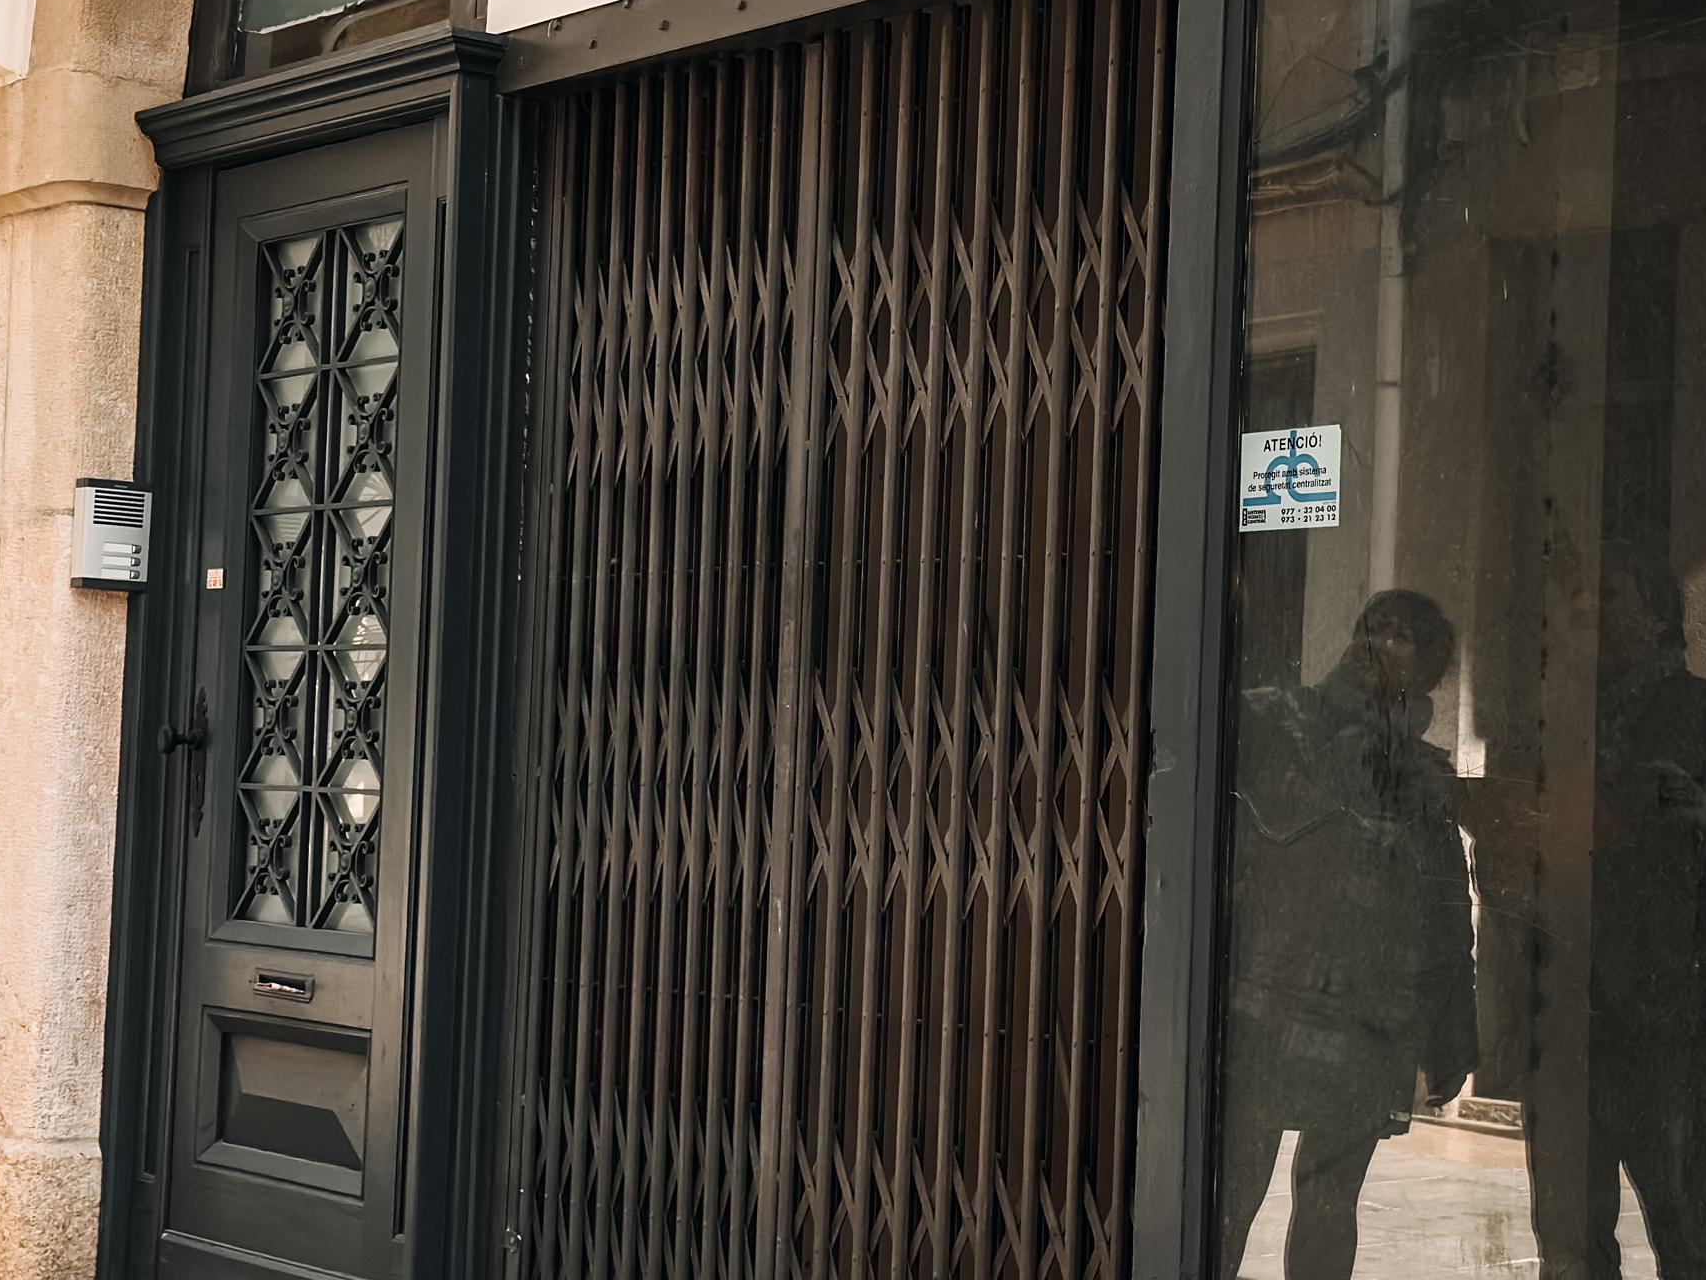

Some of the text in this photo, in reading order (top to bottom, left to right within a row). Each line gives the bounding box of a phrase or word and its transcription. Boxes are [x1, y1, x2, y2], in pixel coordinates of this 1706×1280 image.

[1263, 432, 1322, 452] ATENCIÓ!
[1253, 467, 1326, 481] Protegit amb sistema
[1248, 478, 1331, 493] de seguretat centralitzat
[1327, 513, 1336, 521] 12
